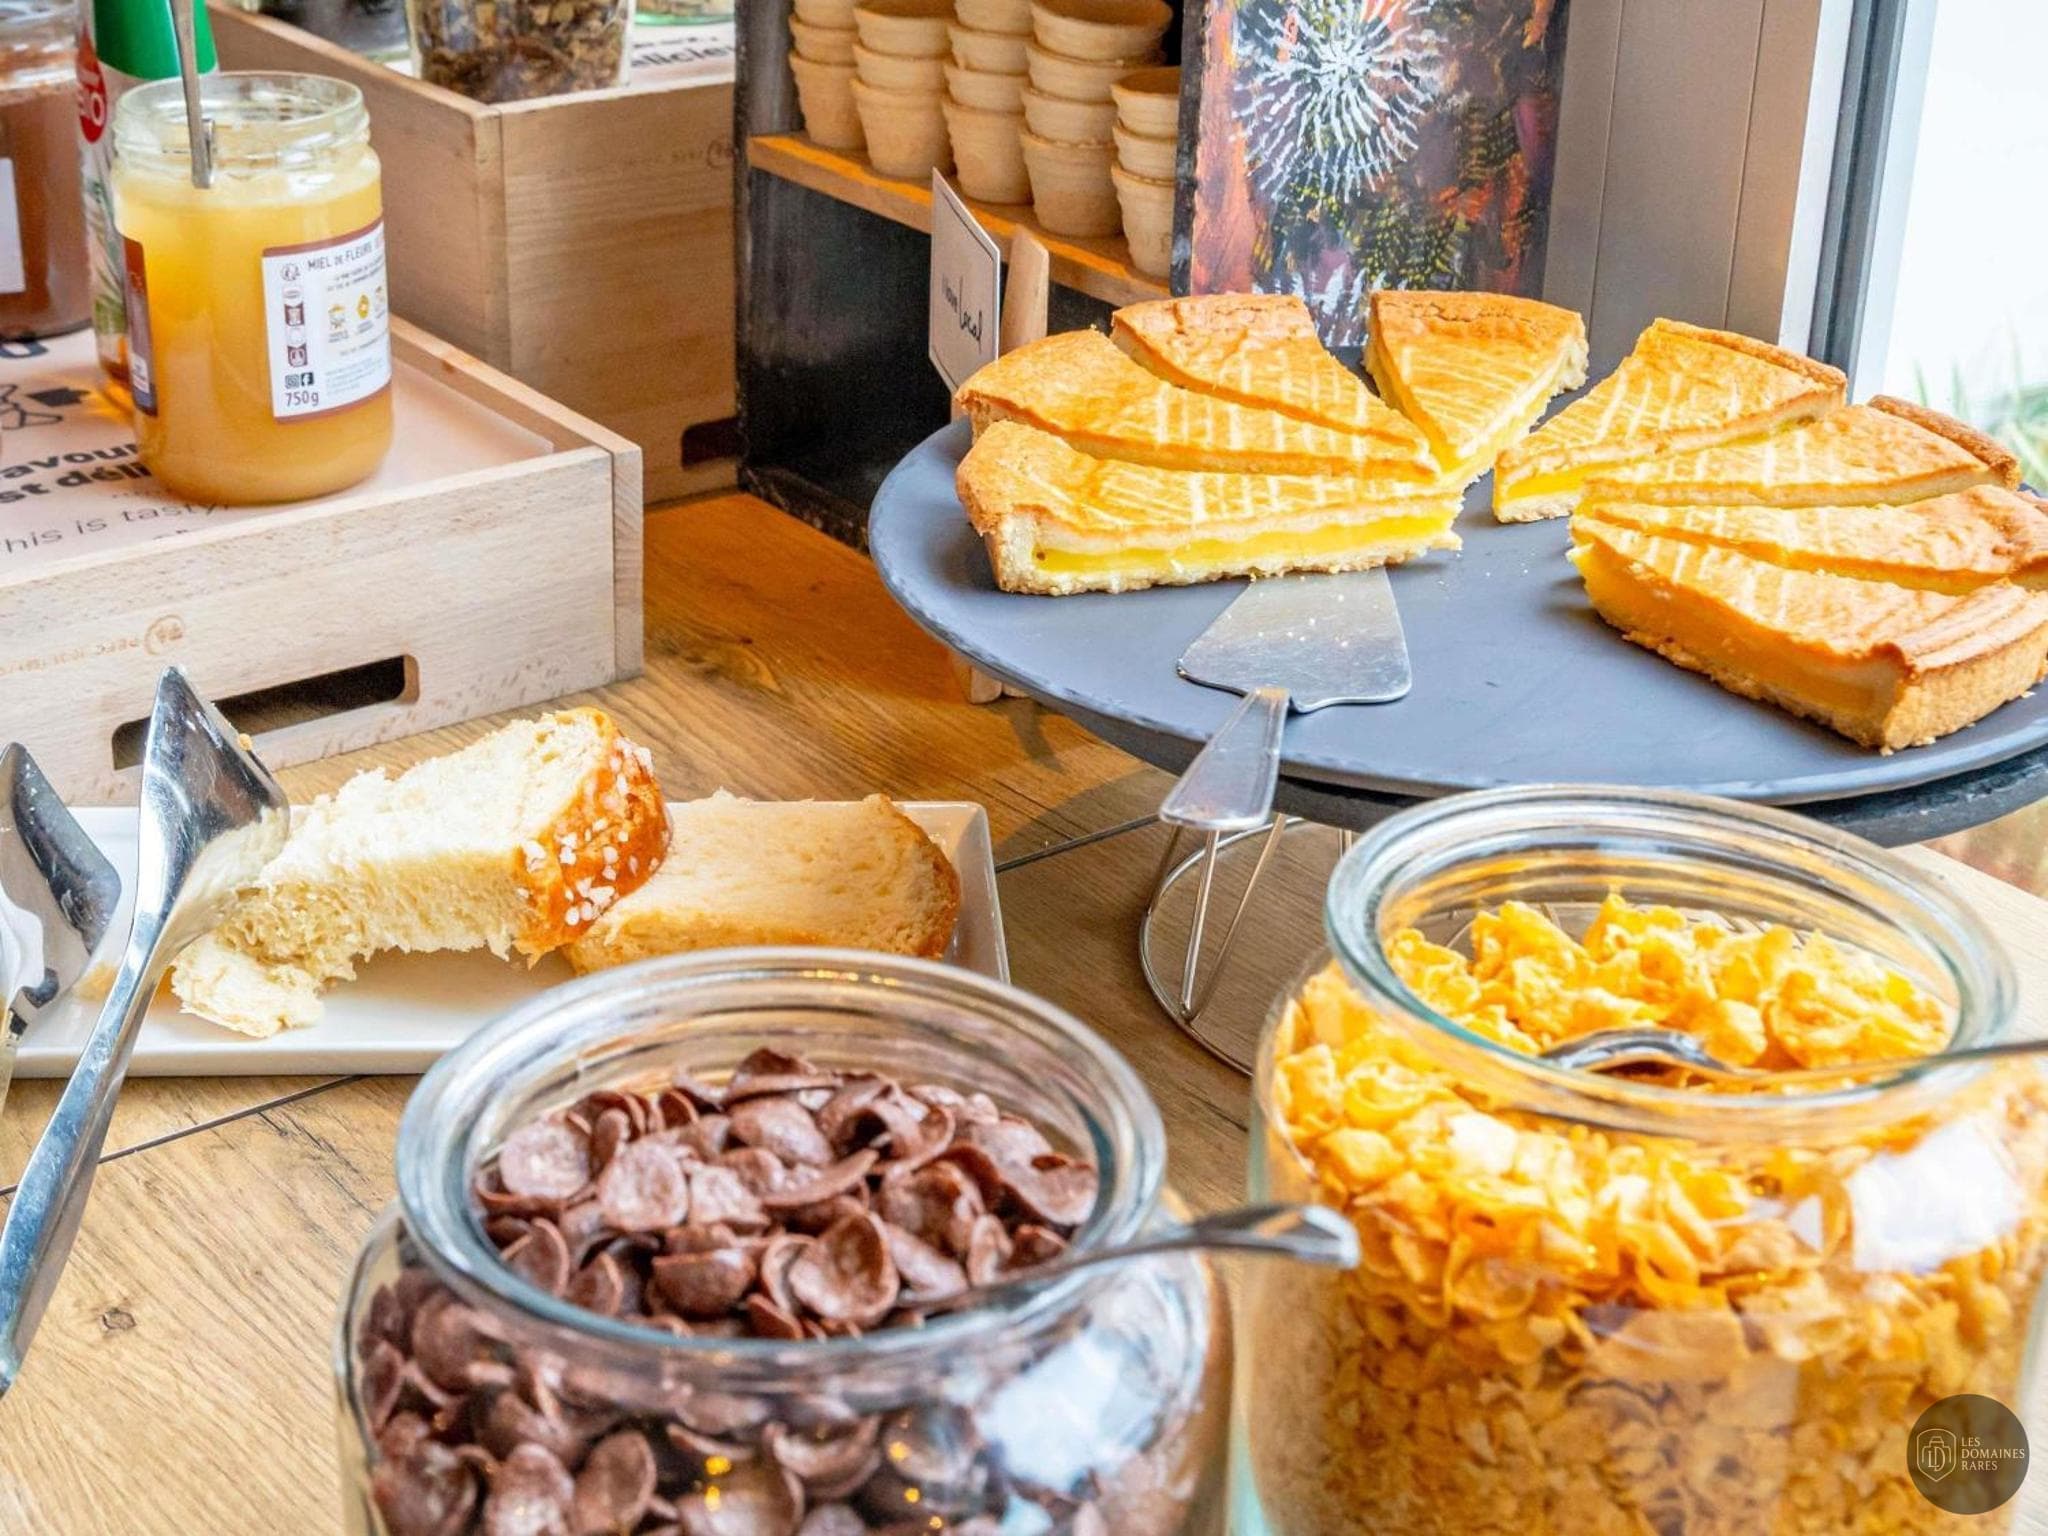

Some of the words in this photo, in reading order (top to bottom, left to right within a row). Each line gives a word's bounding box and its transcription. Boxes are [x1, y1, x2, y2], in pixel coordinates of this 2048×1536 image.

[307, 256, 331, 271] MIEL
[285, 390, 319, 406] 750g
[76, 517, 107, 534] is
